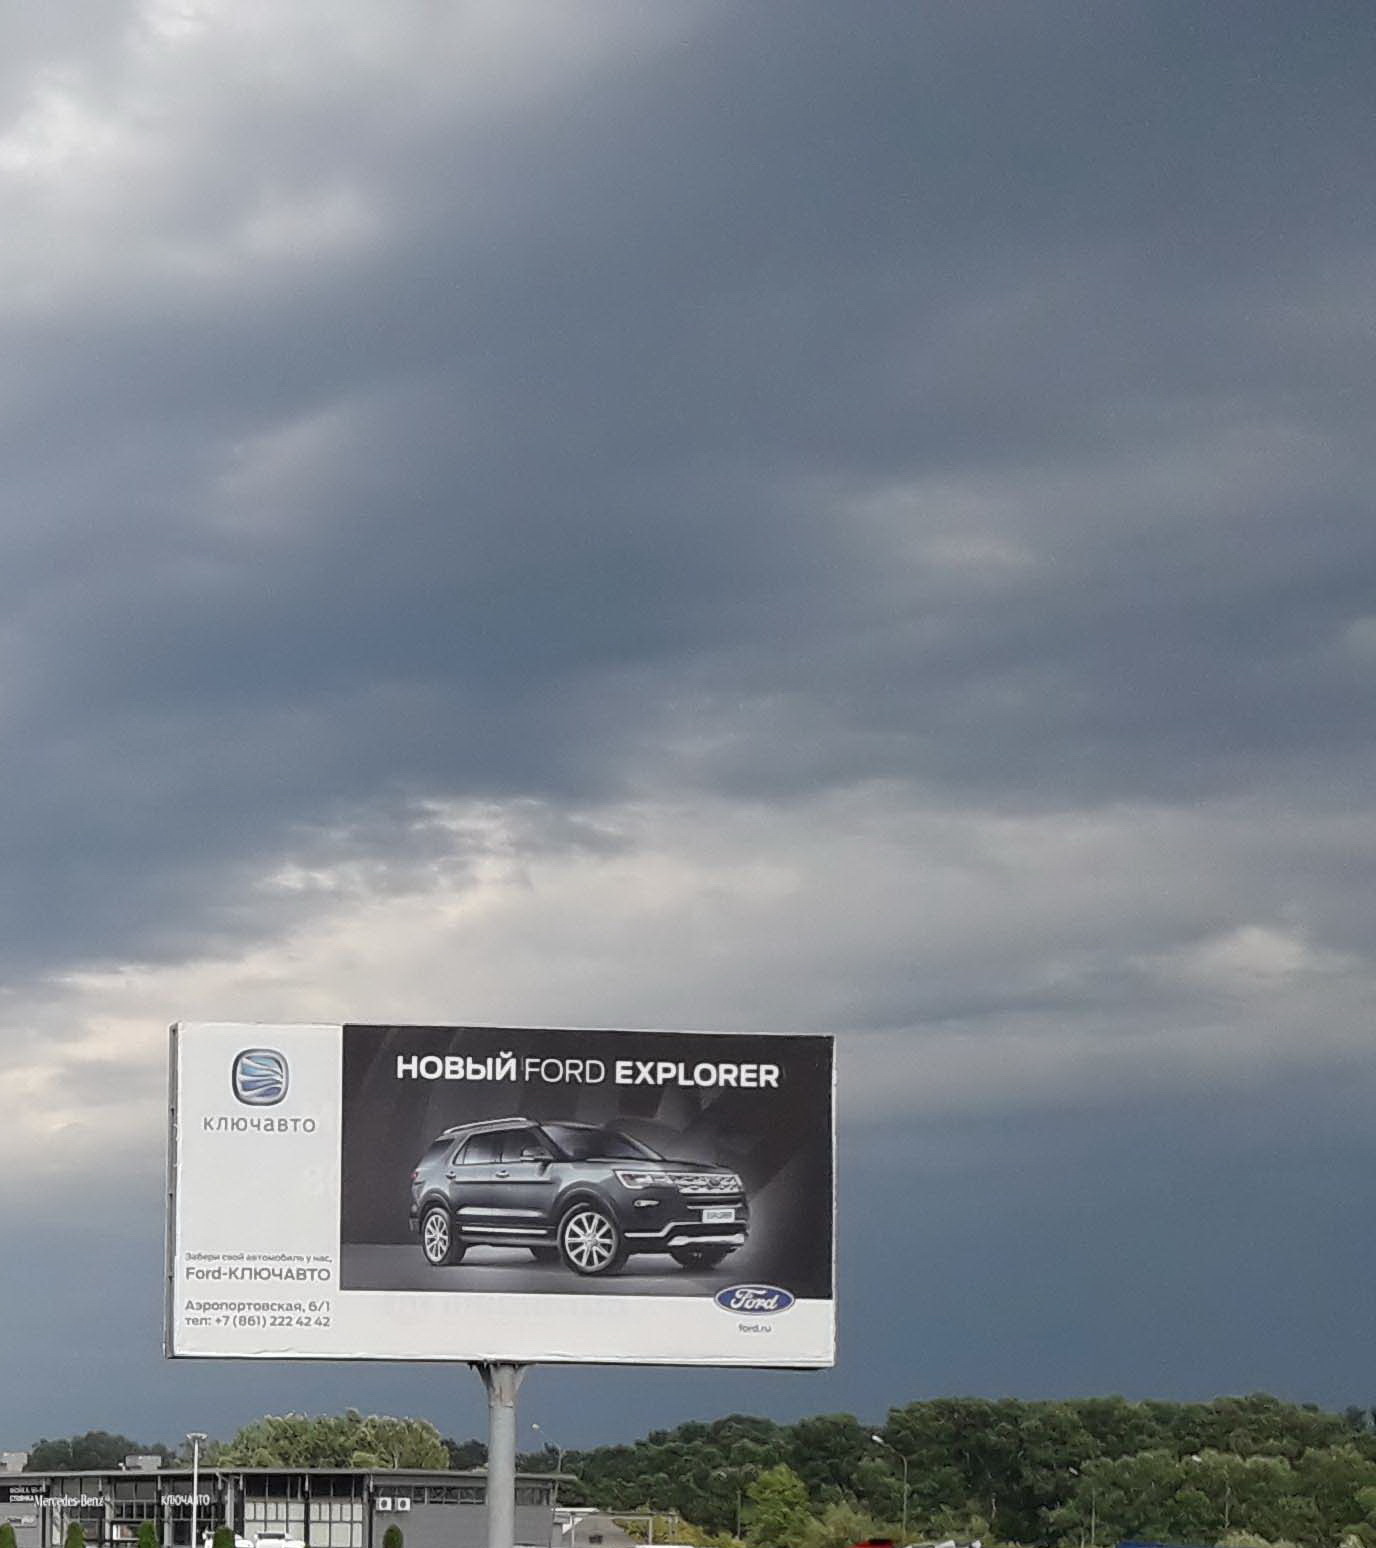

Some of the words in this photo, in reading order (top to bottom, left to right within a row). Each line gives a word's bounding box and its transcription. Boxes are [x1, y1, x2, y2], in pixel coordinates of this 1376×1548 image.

[395, 1051, 517, 1081] НОВЫЙ
[523, 1057, 606, 1084] FORD
[615, 1060, 779, 1089] EXPLORER
[185, 1252, 221, 1262] Забери
[222, 1252, 244, 1262] свой
[246, 1253, 305, 1263] автомобиль
[185, 1266, 332, 1282] Ford-КЛЮЧАВТО
[730, 1288, 779, 1310] Ford
[184, 1300, 306, 1314] Аэропортовская,
[308, 1301, 331, 1313] 6/1
[215, 1315, 231, 1327] +7
[232, 1315, 267, 1329] (861)
[269, 1316, 294, 1328] 222
[295, 1316, 313, 1328] 42
[314, 1316, 331, 1328] 42
[738, 1322, 773, 1334] ford.ru
[34, 1493, 104, 1507] Mercedes-Benz
[160, 1493, 211, 1506] КЛЮЧАТО
